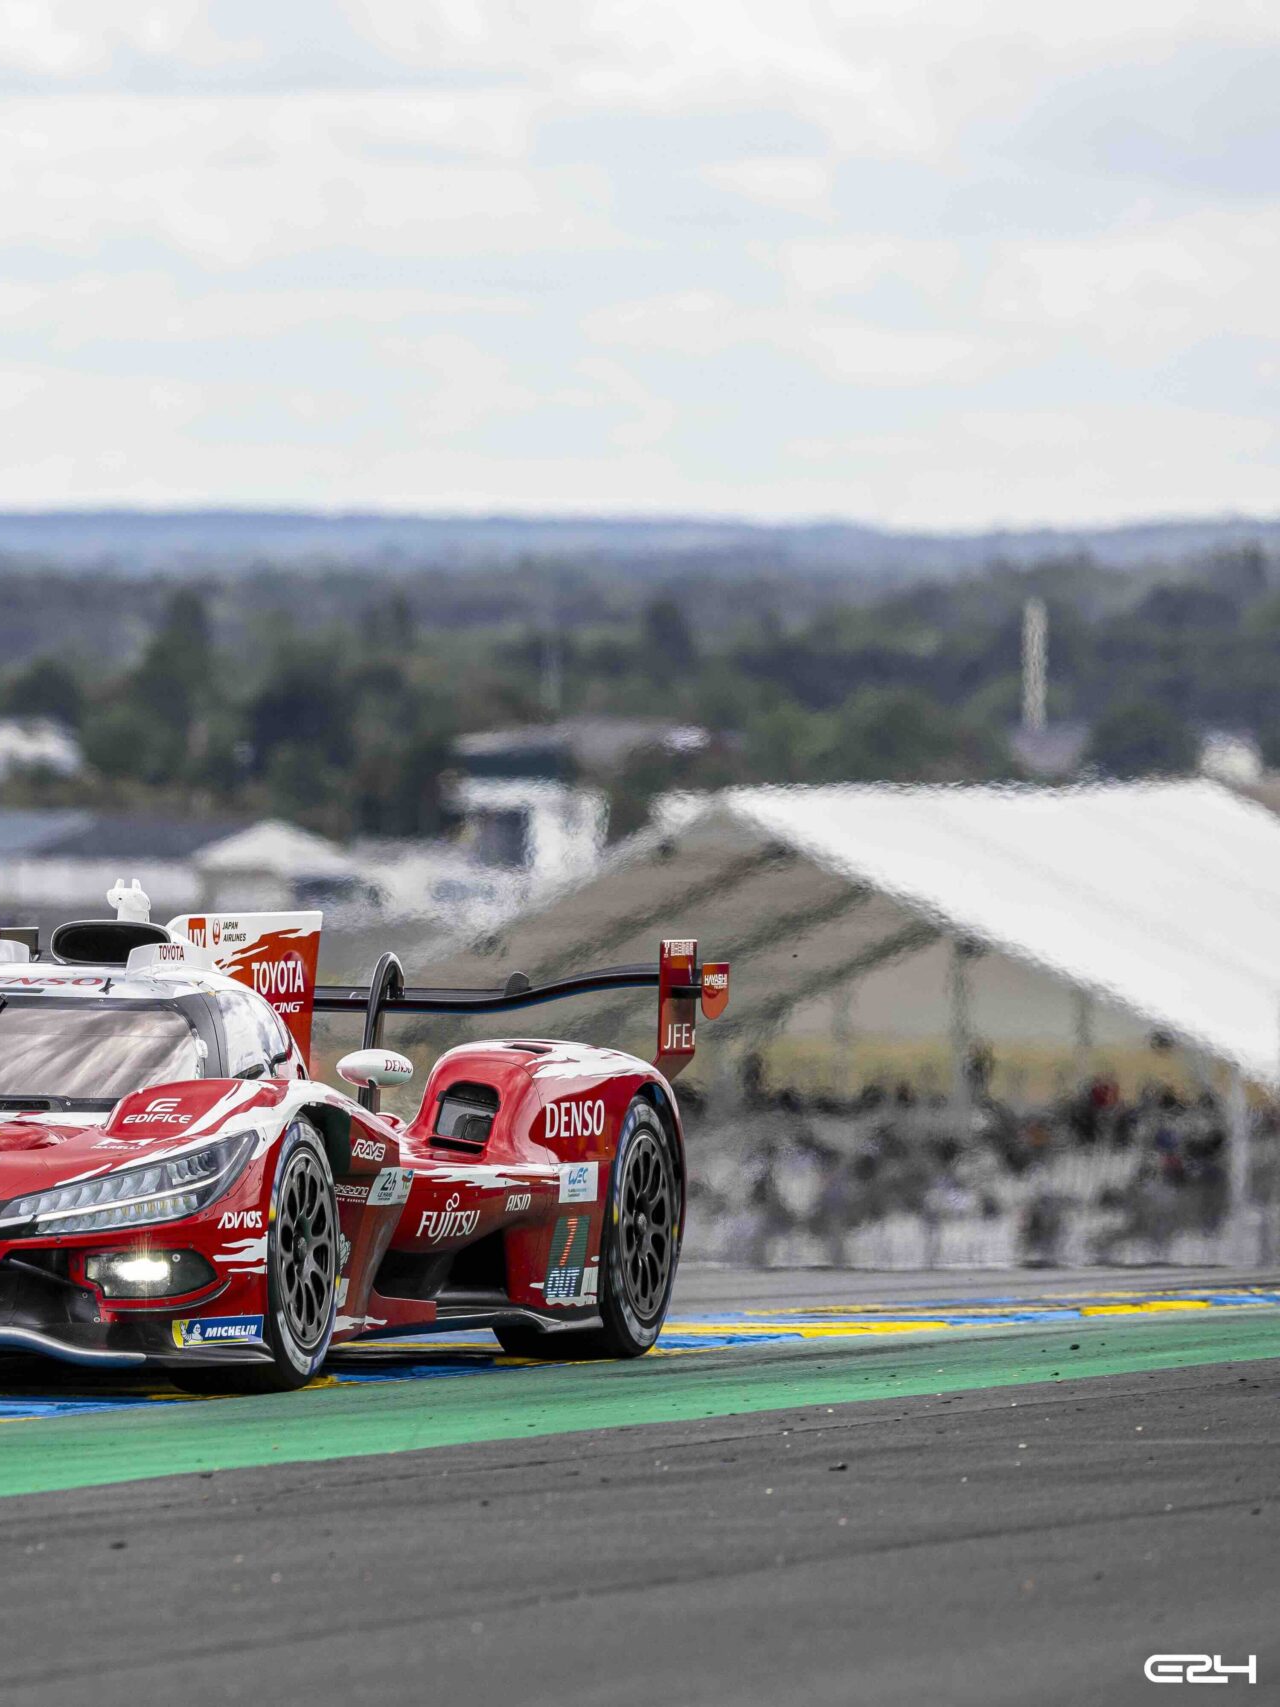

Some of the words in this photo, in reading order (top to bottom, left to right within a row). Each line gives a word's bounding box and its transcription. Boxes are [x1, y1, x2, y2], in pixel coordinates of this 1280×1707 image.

[222, 921, 239, 930] JAPAN
[223, 932, 247, 942] AIRLINES
[158, 945, 185, 961] TOYOTA
[251, 960, 305, 996] TOYOTA
[270, 1001, 304, 1014] CING
[663, 1023, 692, 1050] JFE
[122, 1114, 193, 1125] EDIFICE
[545, 1099, 606, 1139] DENSO
[352, 1138, 386, 1162] RAYS
[568, 1167, 589, 1185] WEC
[505, 1193, 531, 1212] AISIN
[416, 1210, 481, 1245] FUJITSU
[204, 1325, 257, 1338] MICHELIN
